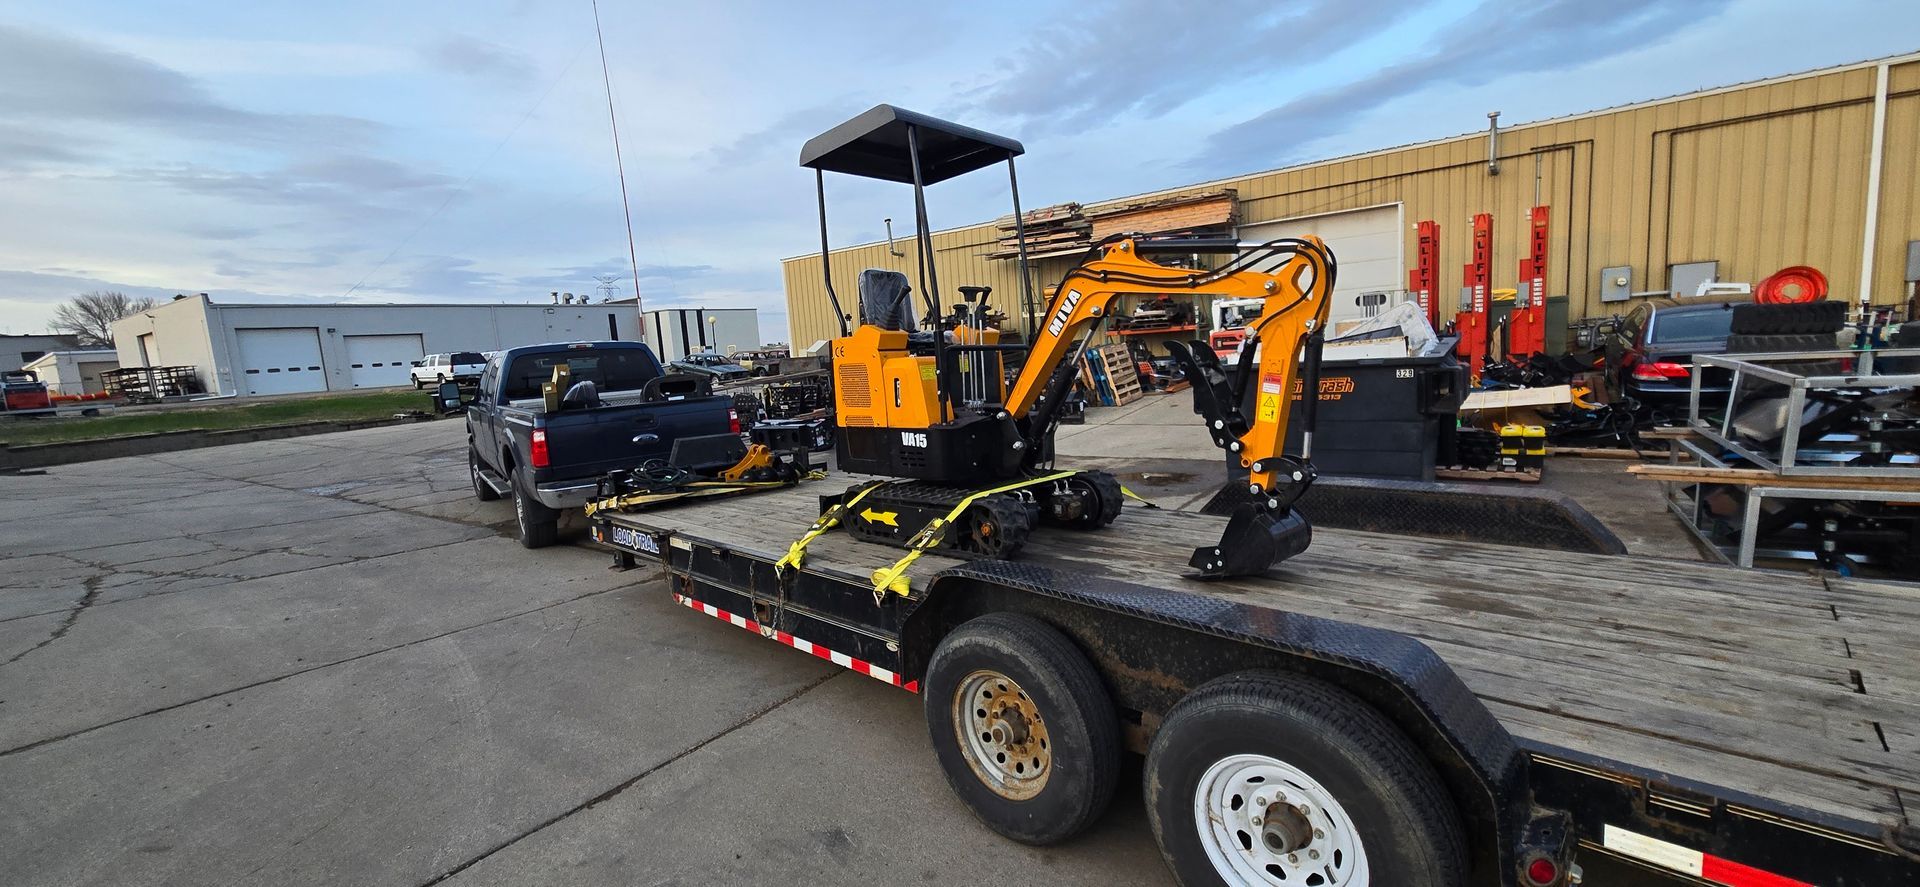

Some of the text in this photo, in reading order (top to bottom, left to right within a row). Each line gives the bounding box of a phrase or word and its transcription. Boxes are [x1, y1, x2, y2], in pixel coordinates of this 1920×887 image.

[1420, 246, 1430, 287] LIFT
[1475, 240, 1485, 282] LIFT
[1534, 231, 1545, 274] LIFT
[1048, 290, 1081, 337] MIVA
[834, 345, 845, 358] CE
[1397, 369, 1413, 378] 329
[901, 431, 928, 449] VA15
[612, 526, 633, 546] LOAD
